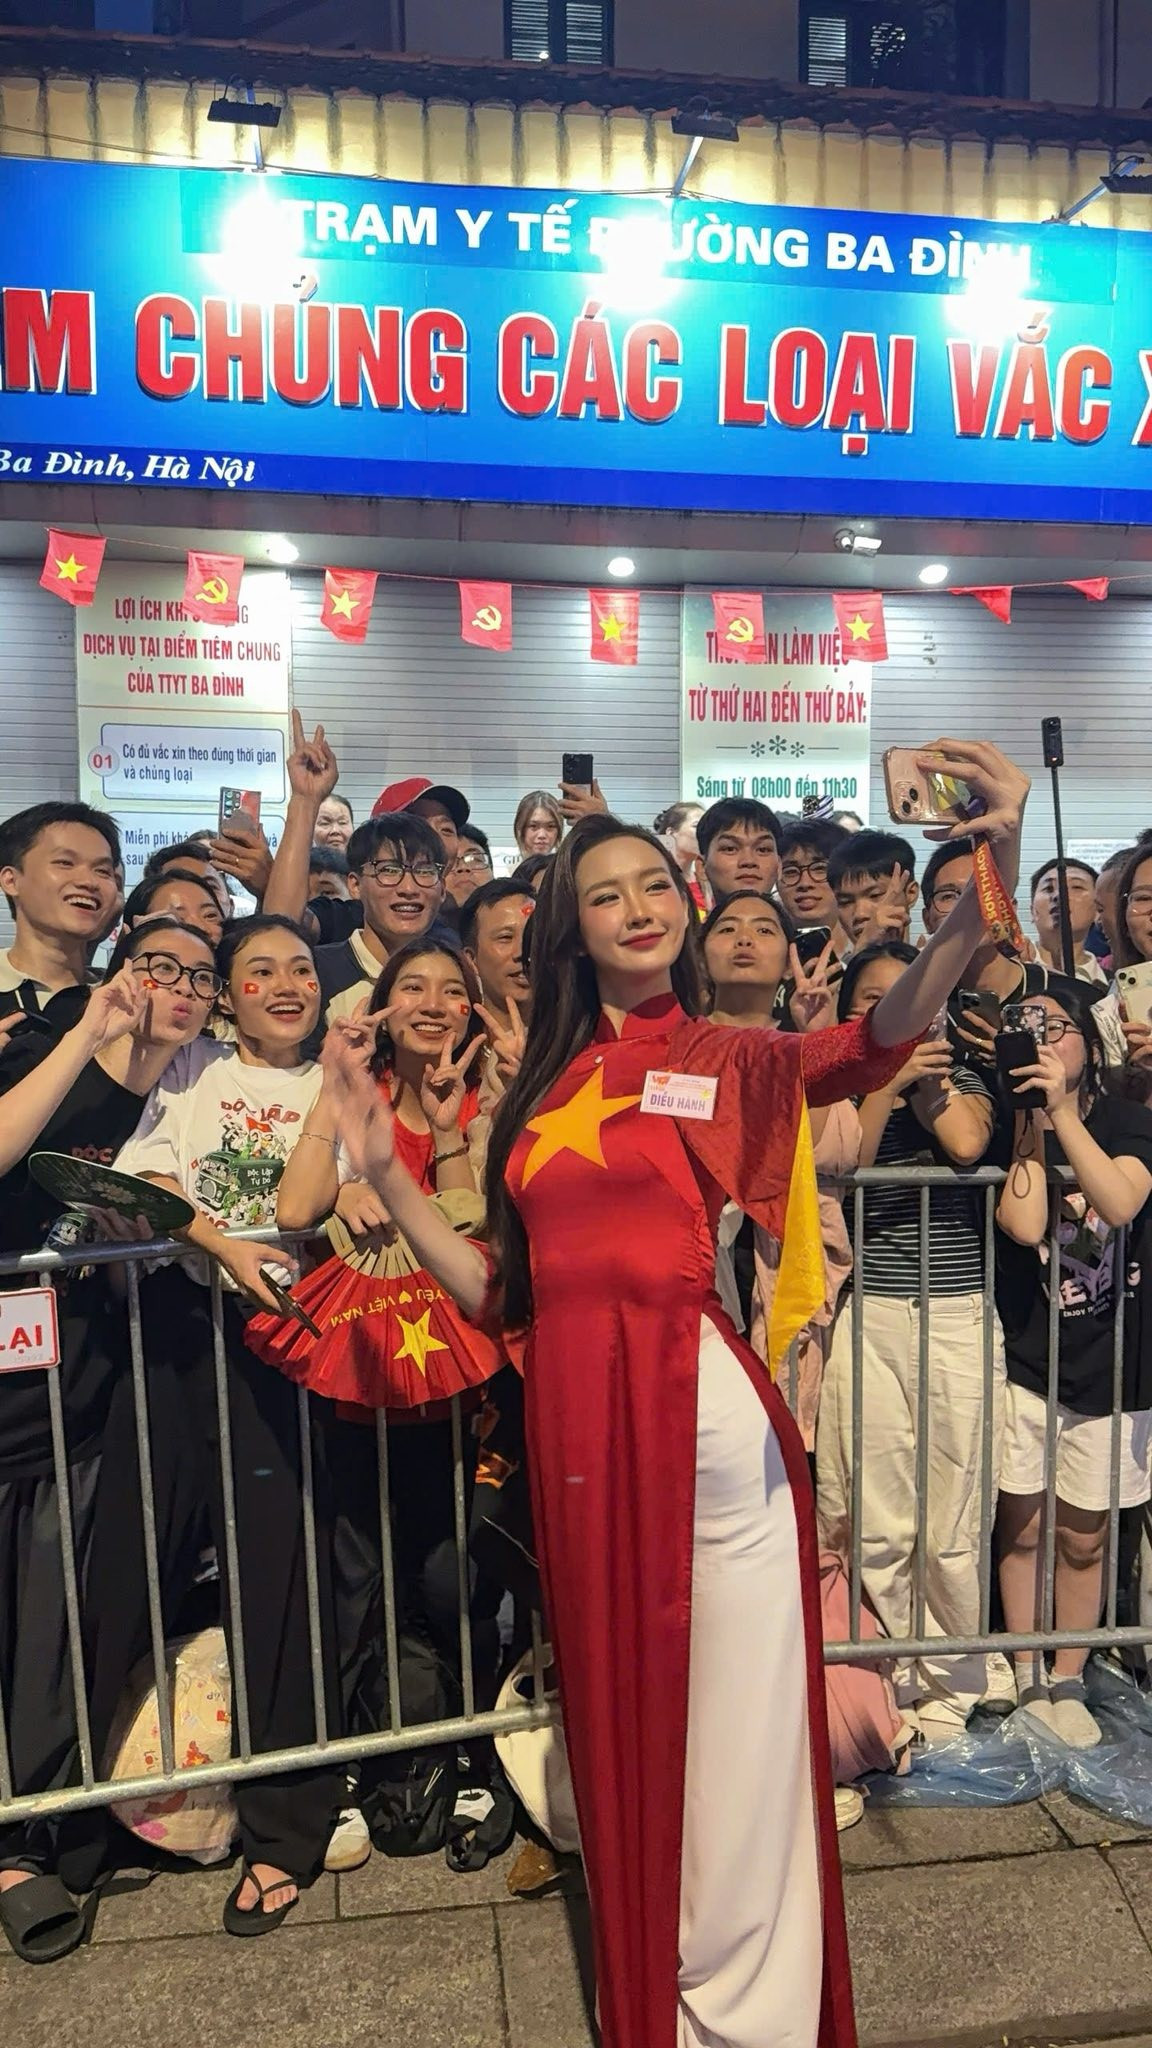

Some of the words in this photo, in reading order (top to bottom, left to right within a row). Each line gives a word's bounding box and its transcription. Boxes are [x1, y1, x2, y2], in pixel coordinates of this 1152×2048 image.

[454, 209, 493, 248] Y
[508, 199, 579, 254] TẾ
[826, 233, 895, 274] BA
[498, 296, 683, 423] CÁC
[719, 323, 917, 456] LOẠI
[948, 310, 1112, 446] VẮC
[42, 450, 135, 482] Đình,
[141, 454, 191, 479] Hà
[198, 456, 256, 488] Nội
[115, 598, 136, 624] LỢI
[140, 596, 162, 621] ÍCH
[83, 633, 115, 660] DỊCH
[118, 635, 136, 662] VỤ
[139, 636, 160, 662] TẠI
[164, 630, 198, 660] ĐIỂM
[202, 635, 233, 660] TIÊM
[783, 626, 814, 665] LÀM
[819, 627, 849, 673] VIỆ
[128, 666, 154, 693] CỦA
[158, 673, 187, 695] TTYT
[192, 675, 209, 695] BA
[213, 672, 244, 697] ĐÌNH
[688, 682, 708, 722] TỪ
[711, 683, 740, 722] THỨ
[743, 691, 767, 722] HAI
[771, 681, 800, 723] ĐẾN
[805, 685, 834, 723] THỨ
[836, 681, 867, 723] BẢY:
[93, 753, 113, 769] 01
[123, 743, 135, 758] Có
[138, 743, 150, 759] đủ
[152, 742, 169, 760] vắc
[172, 745, 186, 760] xin
[188, 746, 208, 761] theo
[211, 746, 234, 765] đúng
[237, 747, 254, 763] thời
[256, 748, 277, 766] gian
[124, 764, 136, 779] và
[139, 764, 170, 784] chủng
[173, 766, 193, 785] loại
[697, 776, 728, 799] Sáng
[732, 777, 746, 798] từ
[752, 776, 791, 799] 08h00
[795, 774, 818, 799] đến
[822, 777, 857, 799] 11h30
[153, 830, 169, 848] phí
[126, 853, 144, 866] sau
[367, 1294, 396, 1315] VIỆT
[416, 1288, 445, 1303] YÊU
[330, 1306, 364, 1328] NAM
